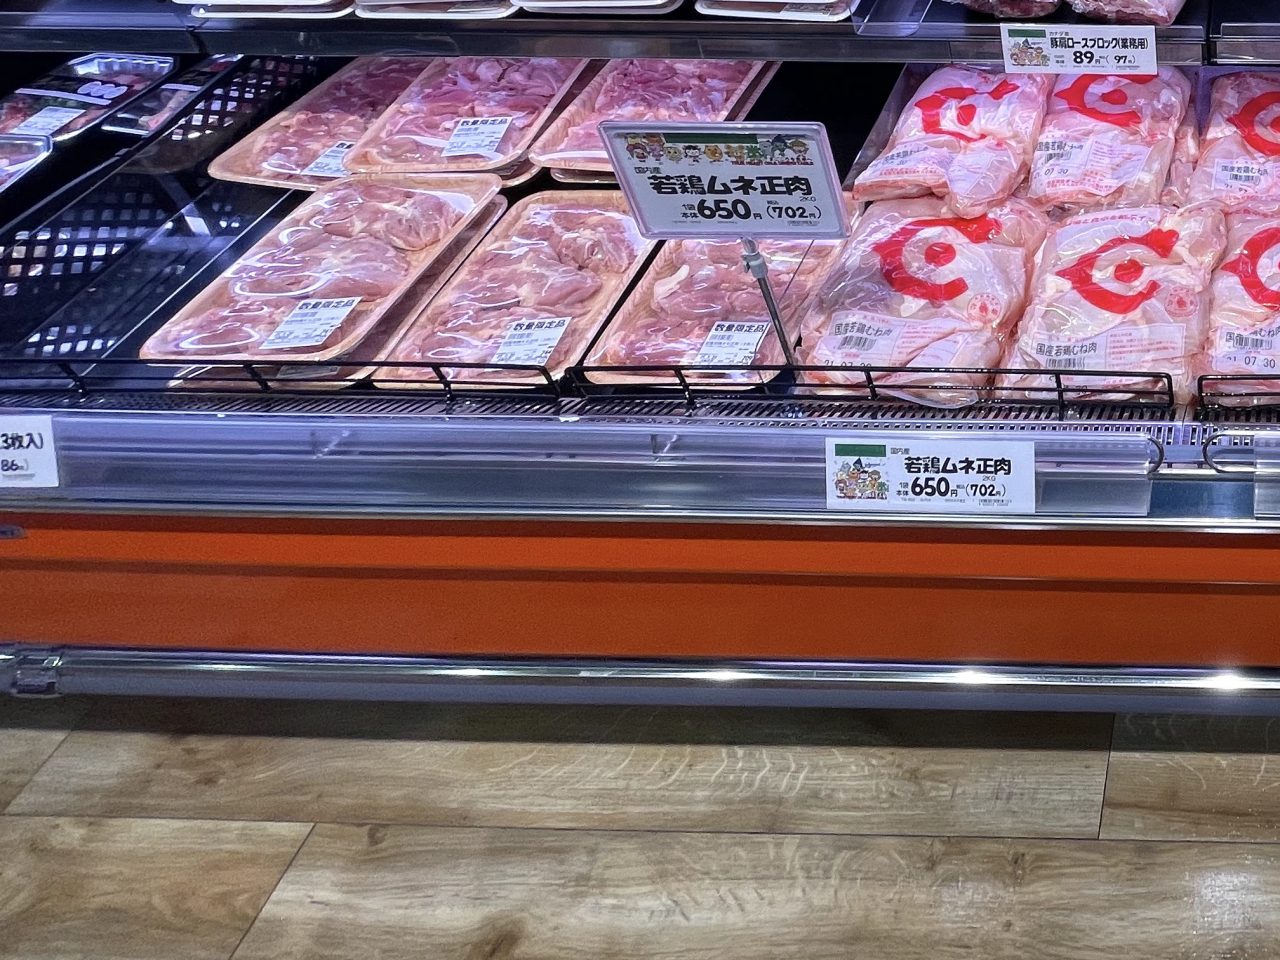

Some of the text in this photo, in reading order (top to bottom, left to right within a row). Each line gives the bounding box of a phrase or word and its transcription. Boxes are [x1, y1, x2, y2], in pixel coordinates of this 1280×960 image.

[647, 174, 813, 196] 若鶏ムネ正肉
[714, 323, 765, 333] 数量限定品
[1035, 342, 1098, 357] 国産若鶏むね肉
[904, 456, 1012, 475] 若鶏ムネ正肉
